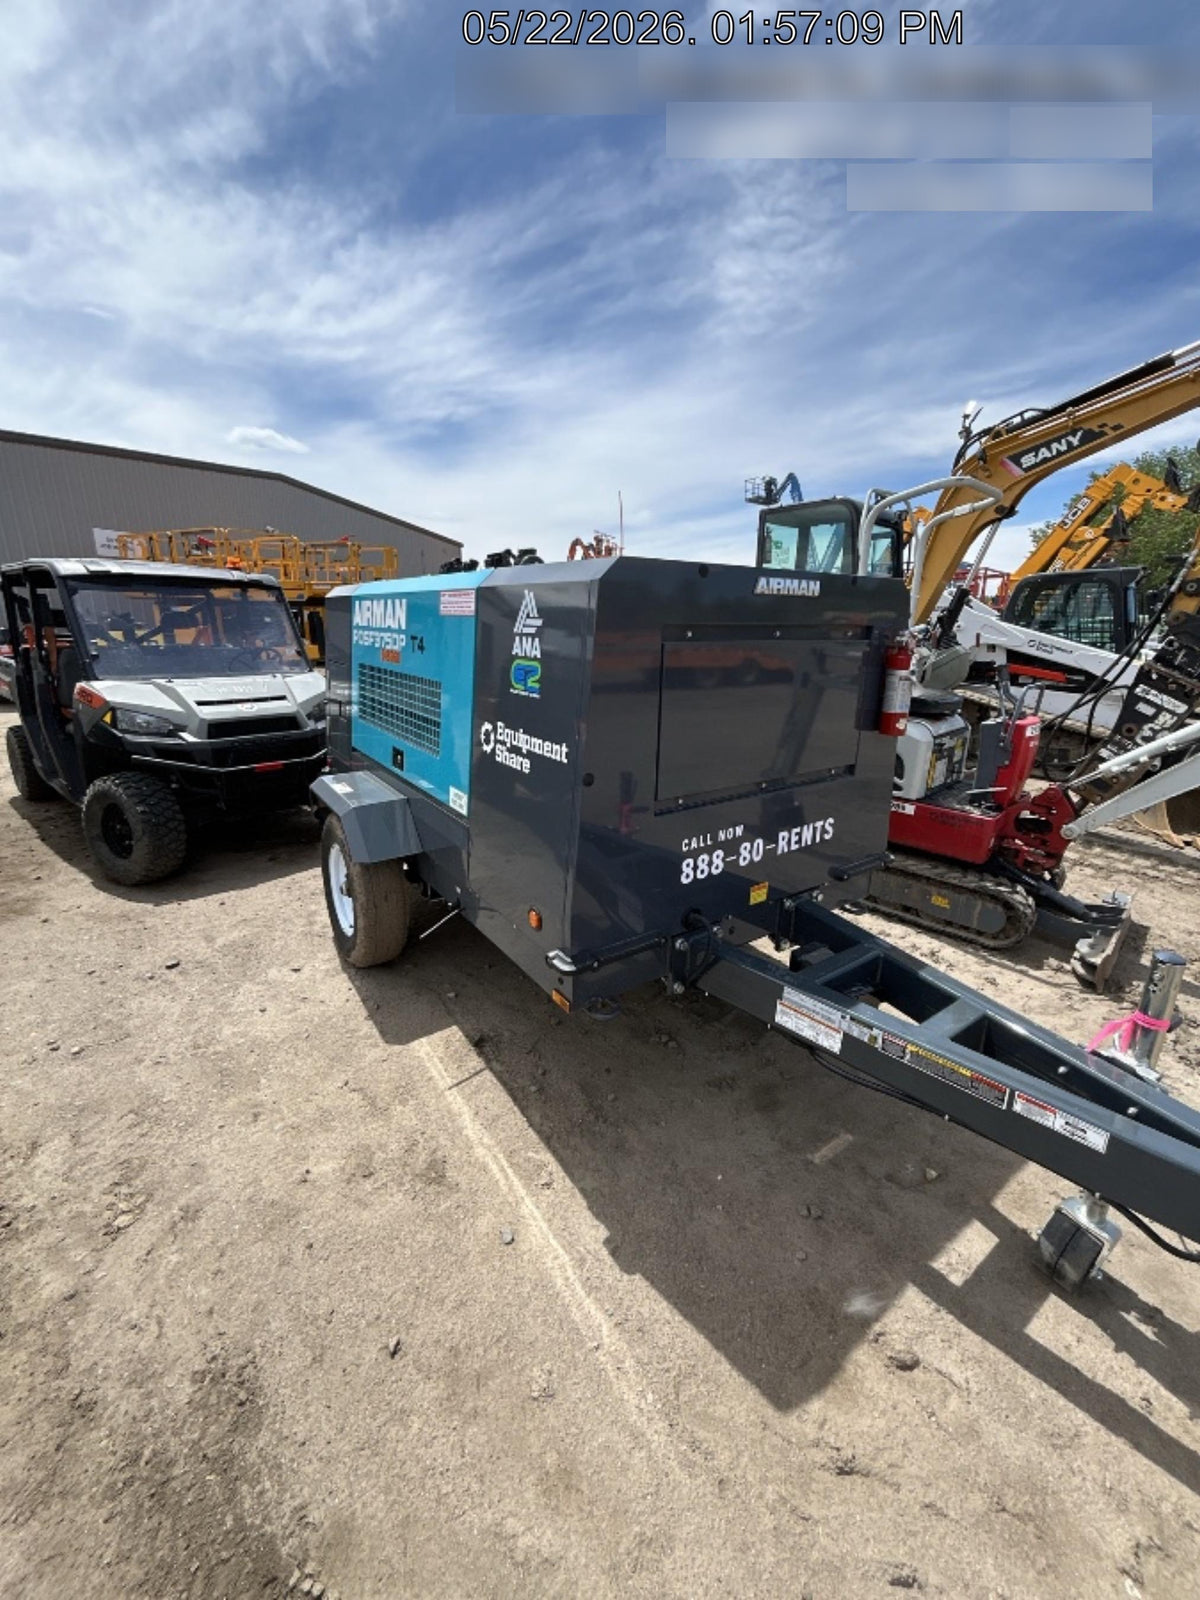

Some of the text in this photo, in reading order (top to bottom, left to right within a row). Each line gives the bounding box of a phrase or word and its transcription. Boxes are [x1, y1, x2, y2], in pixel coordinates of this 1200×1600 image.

[1020, 429, 1084, 469] SANY
[1060, 496, 1093, 529] JCB
[753, 576, 821, 597] AIRMAN
[353, 598, 407, 630] AIRMAN
[410, 635, 426, 655] T4
[511, 636, 541, 658] ANA
[496, 721, 569, 764] Equipment
[495, 743, 531, 774] Share
[680, 817, 835, 884] 888-80-RENTS
[682, 824, 744, 852] CALL NOW
